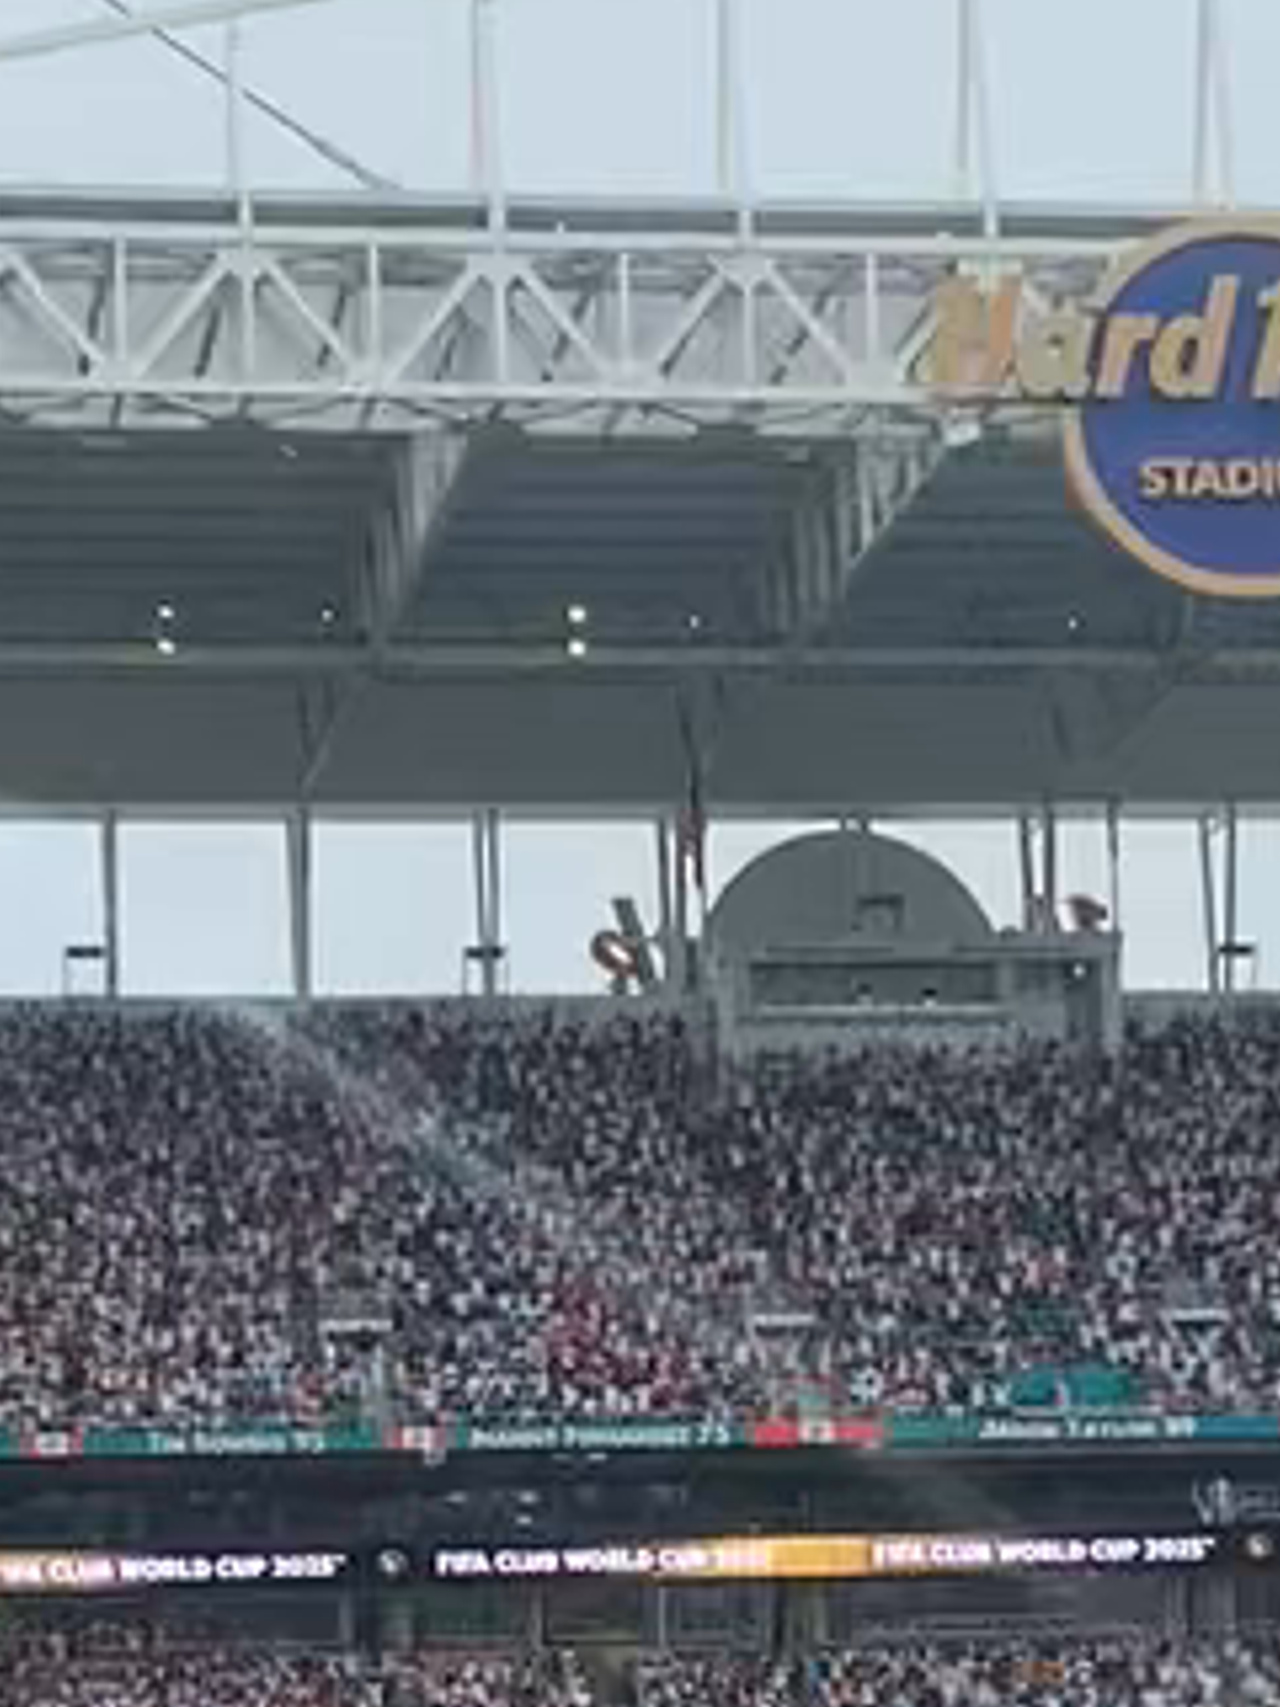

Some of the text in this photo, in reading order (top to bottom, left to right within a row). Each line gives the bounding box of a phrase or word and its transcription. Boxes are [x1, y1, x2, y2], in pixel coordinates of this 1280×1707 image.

[923, 275, 1238, 400] Hard
[1091, 1539, 1138, 1561] CUP
[216, 1555, 267, 1579] CUP
